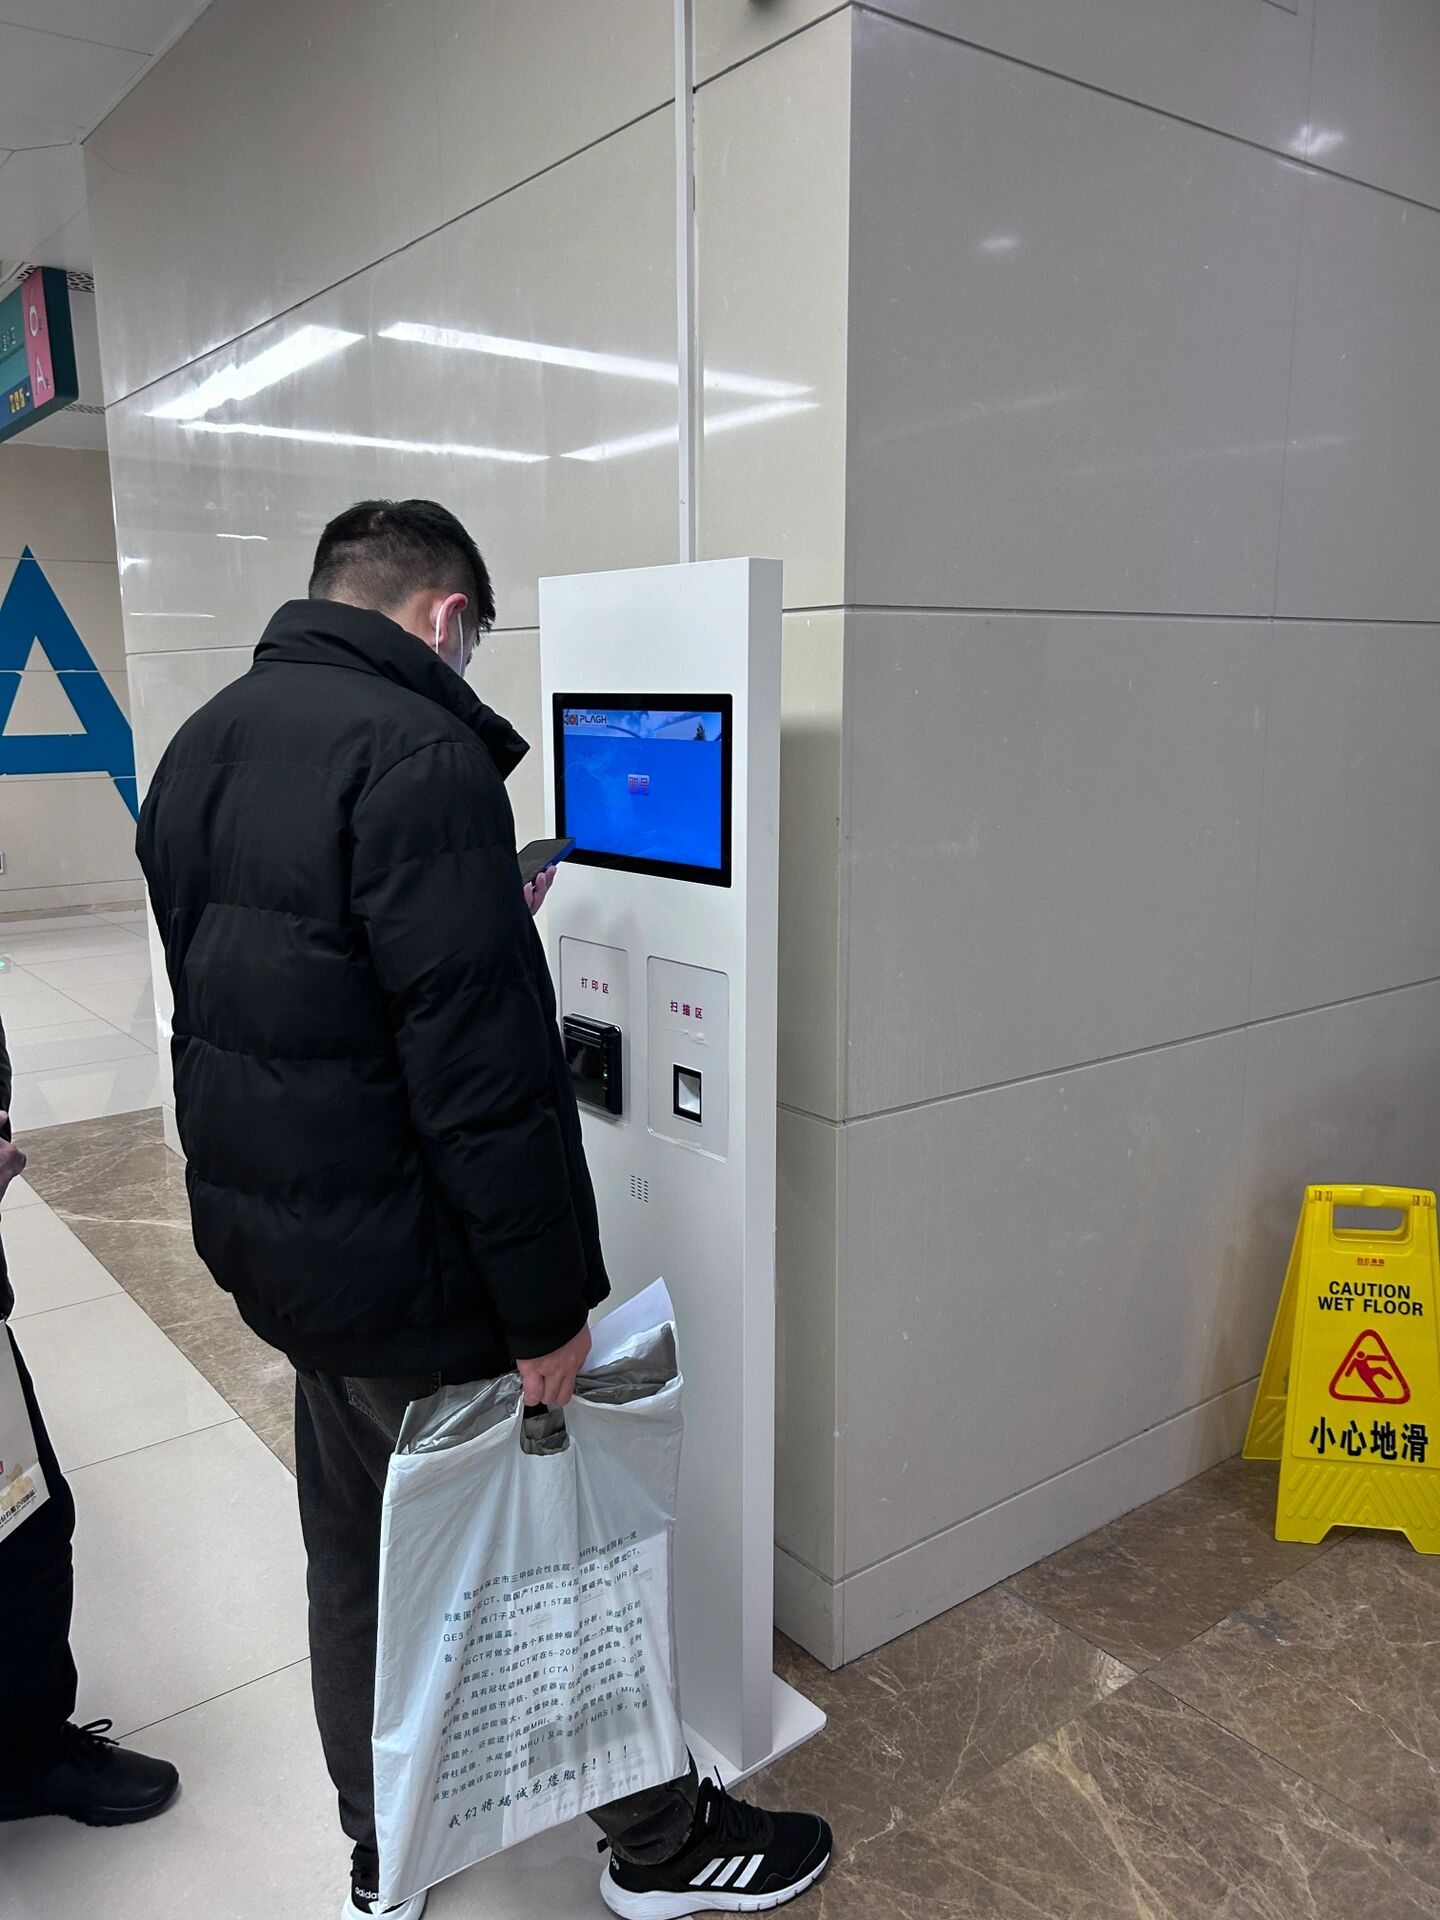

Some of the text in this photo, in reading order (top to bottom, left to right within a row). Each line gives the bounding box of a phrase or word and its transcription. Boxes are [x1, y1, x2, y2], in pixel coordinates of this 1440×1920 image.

[0, 545, 139, 824] A
[579, 714, 607, 724] PLAGH
[580, 976, 610, 995] 打印区
[669, 999, 703, 1020] 扫描区
[1329, 1280, 1411, 1300] CAUTION
[1317, 1296, 1424, 1317] WET FLOOR
[1309, 1416, 1429, 1464] 小心地滑
[355, 1886, 380, 1899] adida
